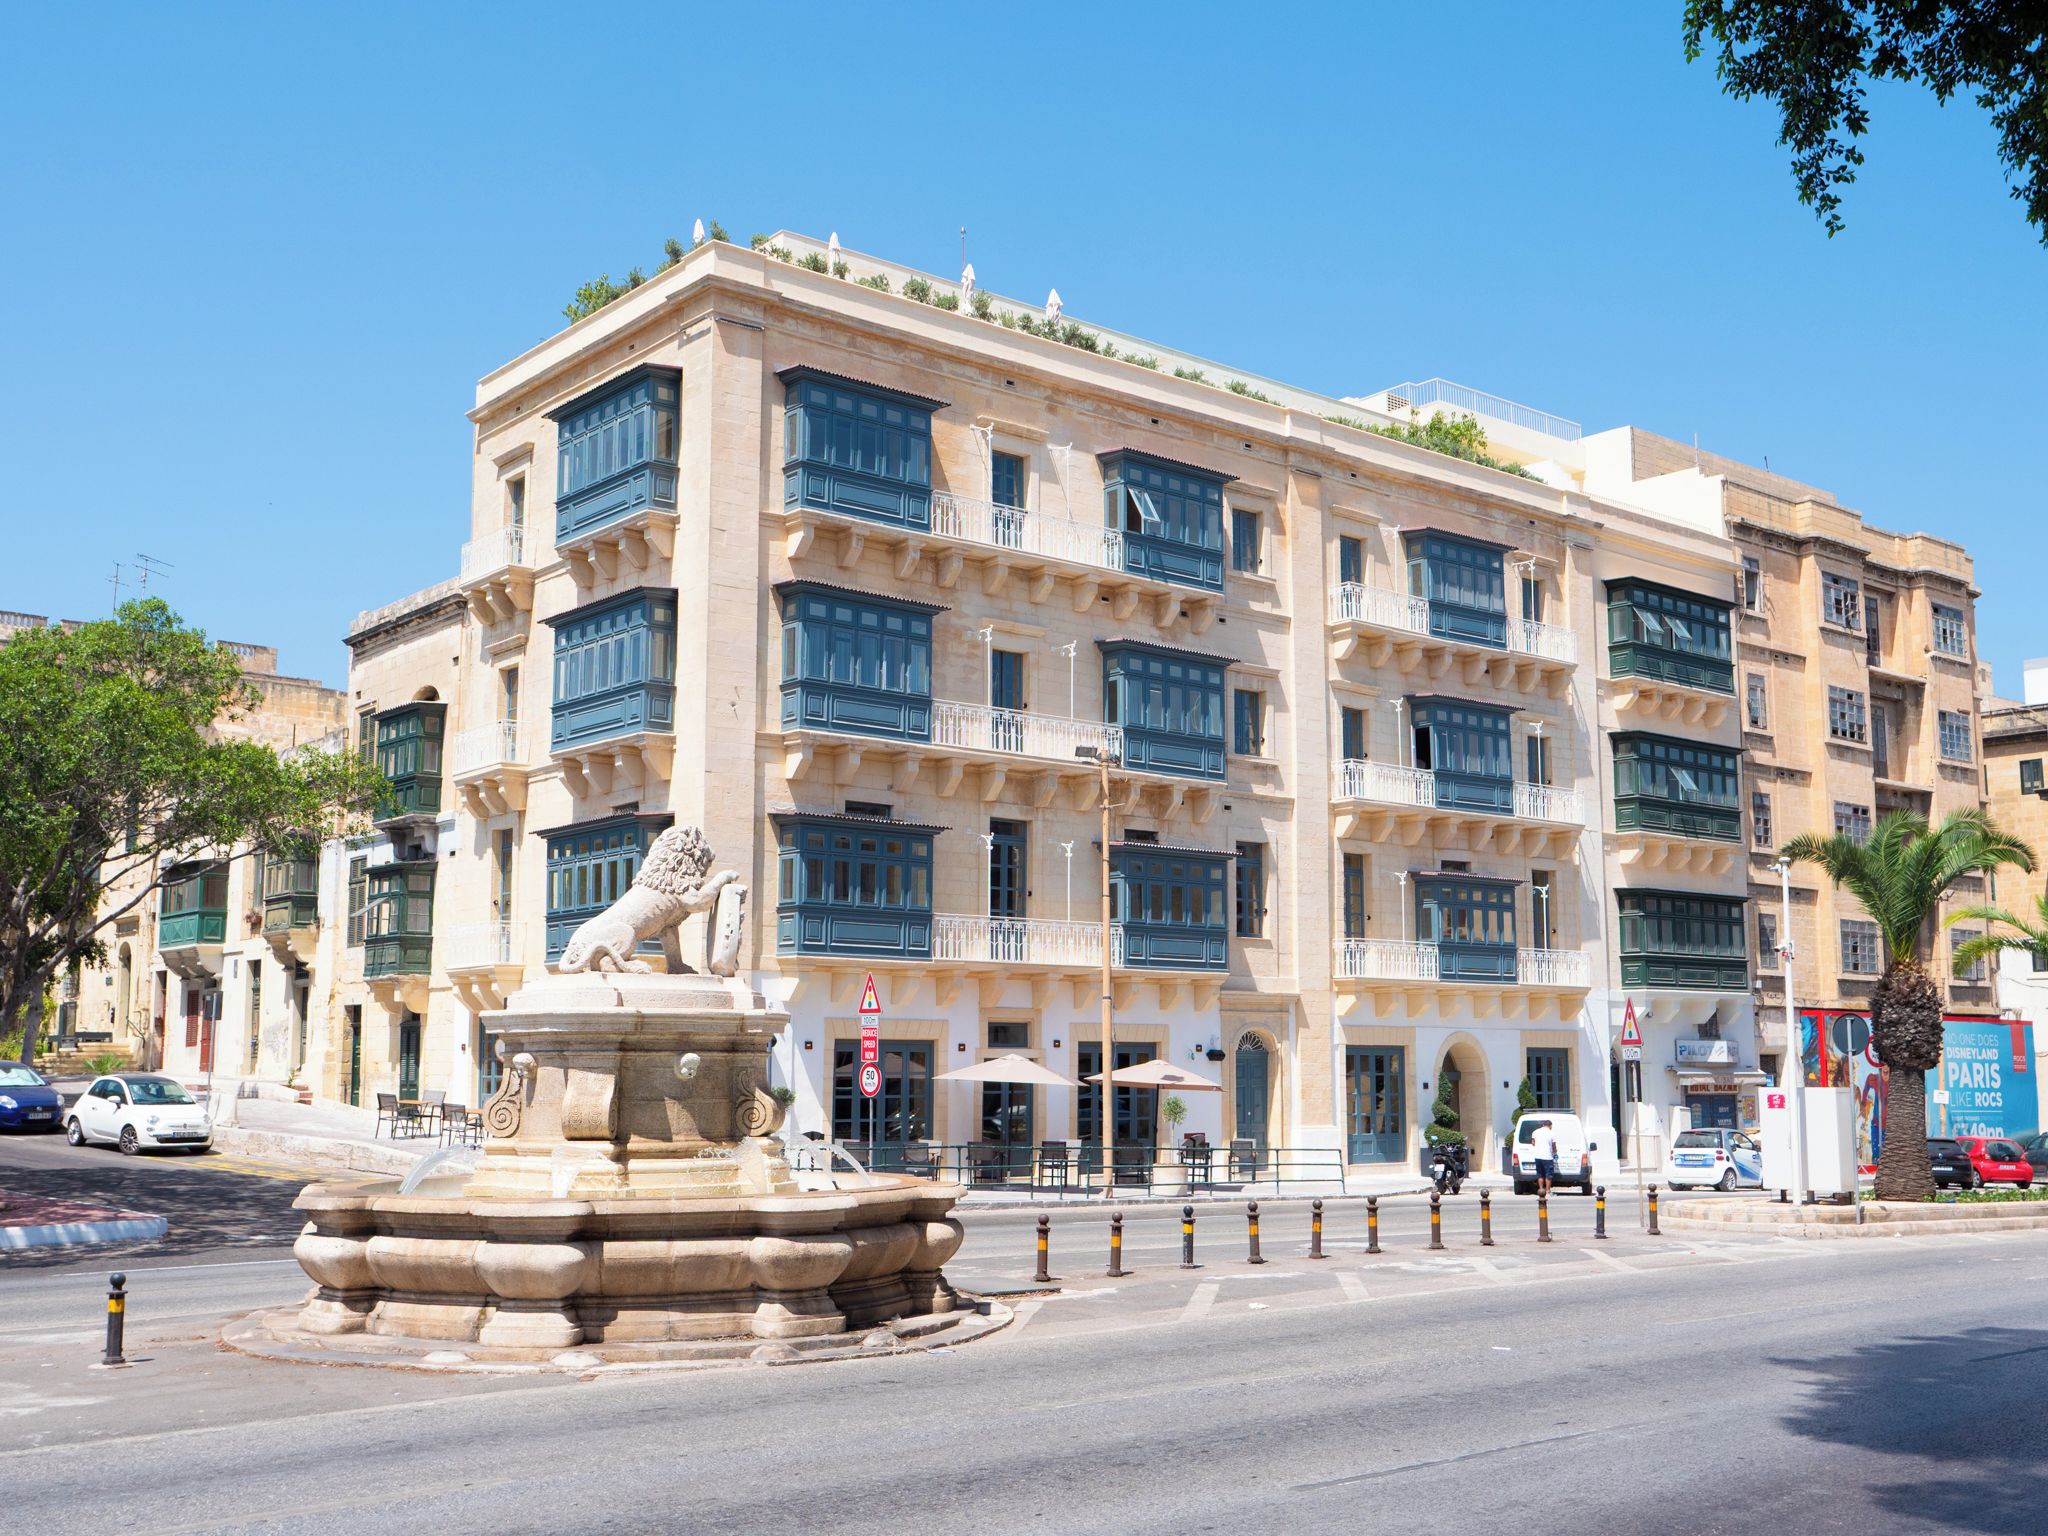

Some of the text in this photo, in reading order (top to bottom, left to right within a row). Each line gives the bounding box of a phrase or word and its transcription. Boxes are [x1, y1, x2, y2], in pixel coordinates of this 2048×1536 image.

[862, 1029, 878, 1037] REDUCE
[863, 1040, 876, 1048] SPEED
[1945, 1032, 1999, 1047] NO ONE DOES
[864, 1051, 875, 1059] NOW
[1946, 1047, 1999, 1060] DISNEYLAND
[866, 1070, 875, 1080] 50
[1948, 1062, 2001, 1089] PARIS
[1950, 1091, 2002, 1107] LIKE ROCS
